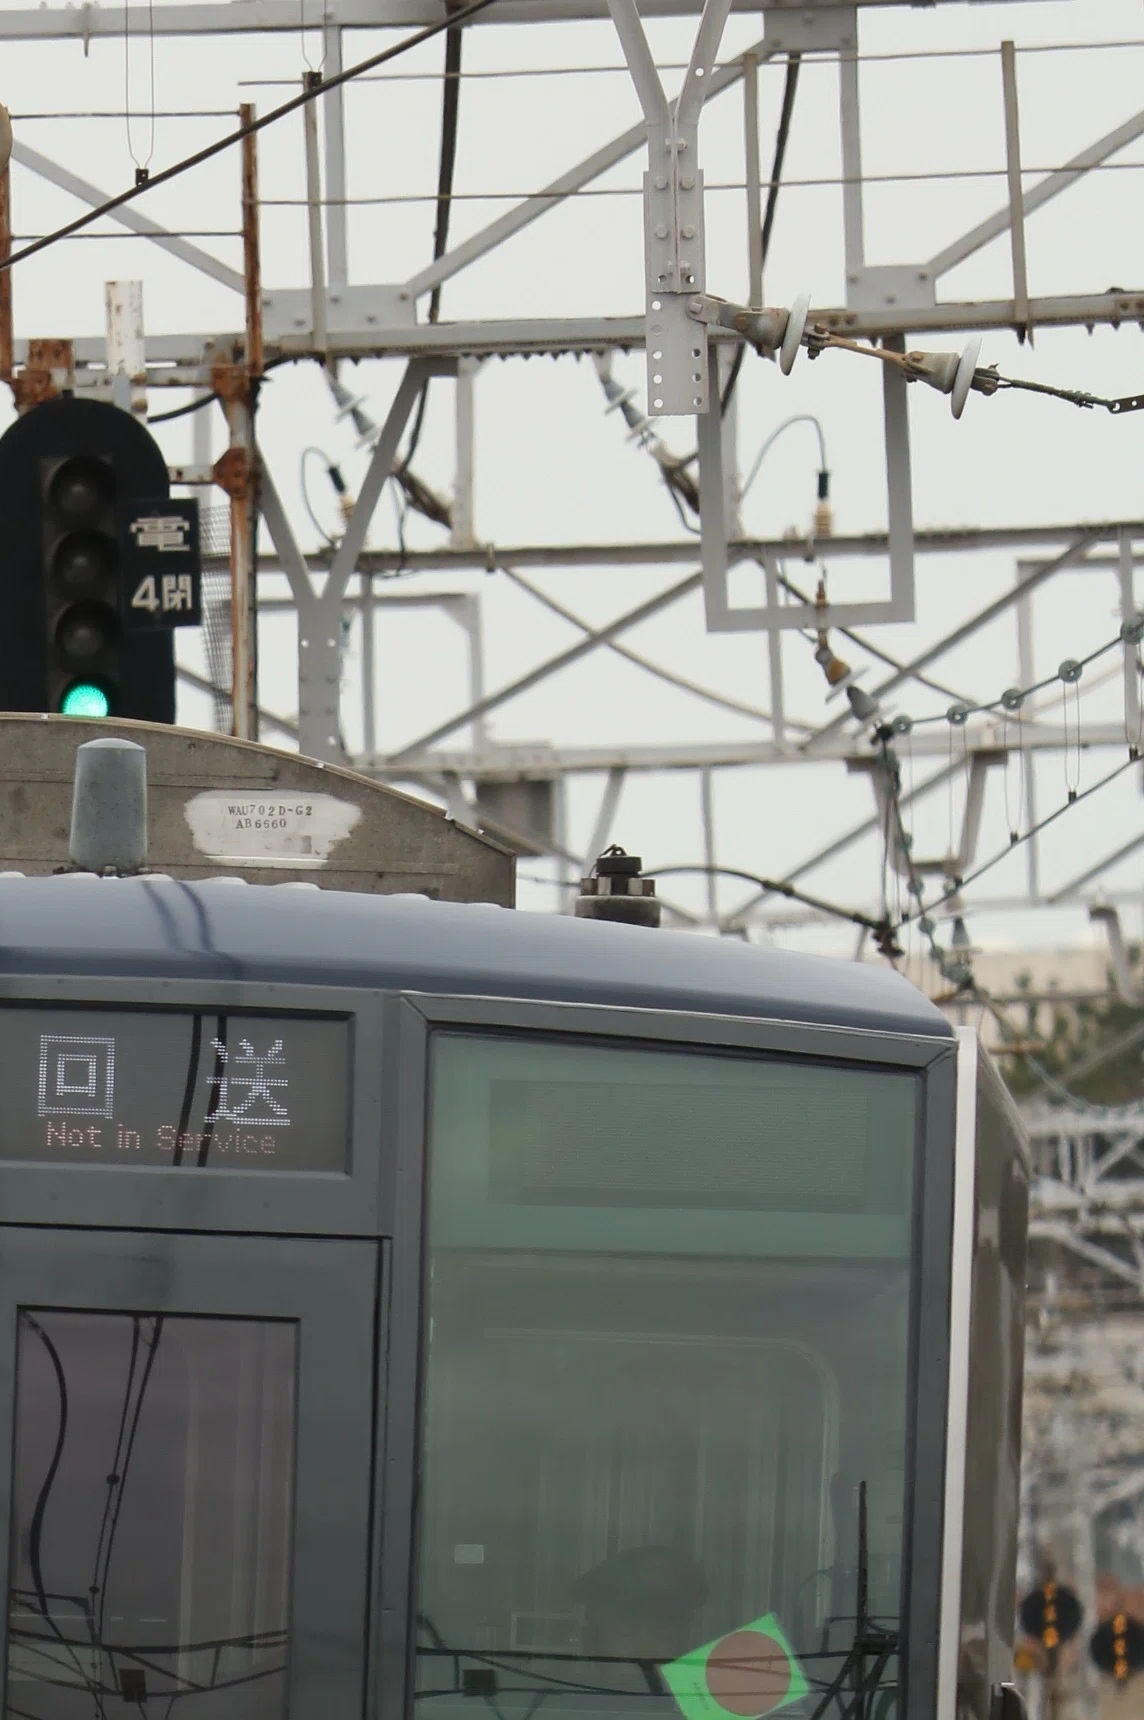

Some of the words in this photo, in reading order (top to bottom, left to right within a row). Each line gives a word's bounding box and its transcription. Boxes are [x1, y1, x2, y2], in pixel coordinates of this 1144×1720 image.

[130, 515, 191, 551] 電
[37, 1034, 291, 1126] 回送
[45, 1121, 102, 1149] Not
[117, 1123, 141, 1150] in
[156, 1124, 276, 1155] Service
